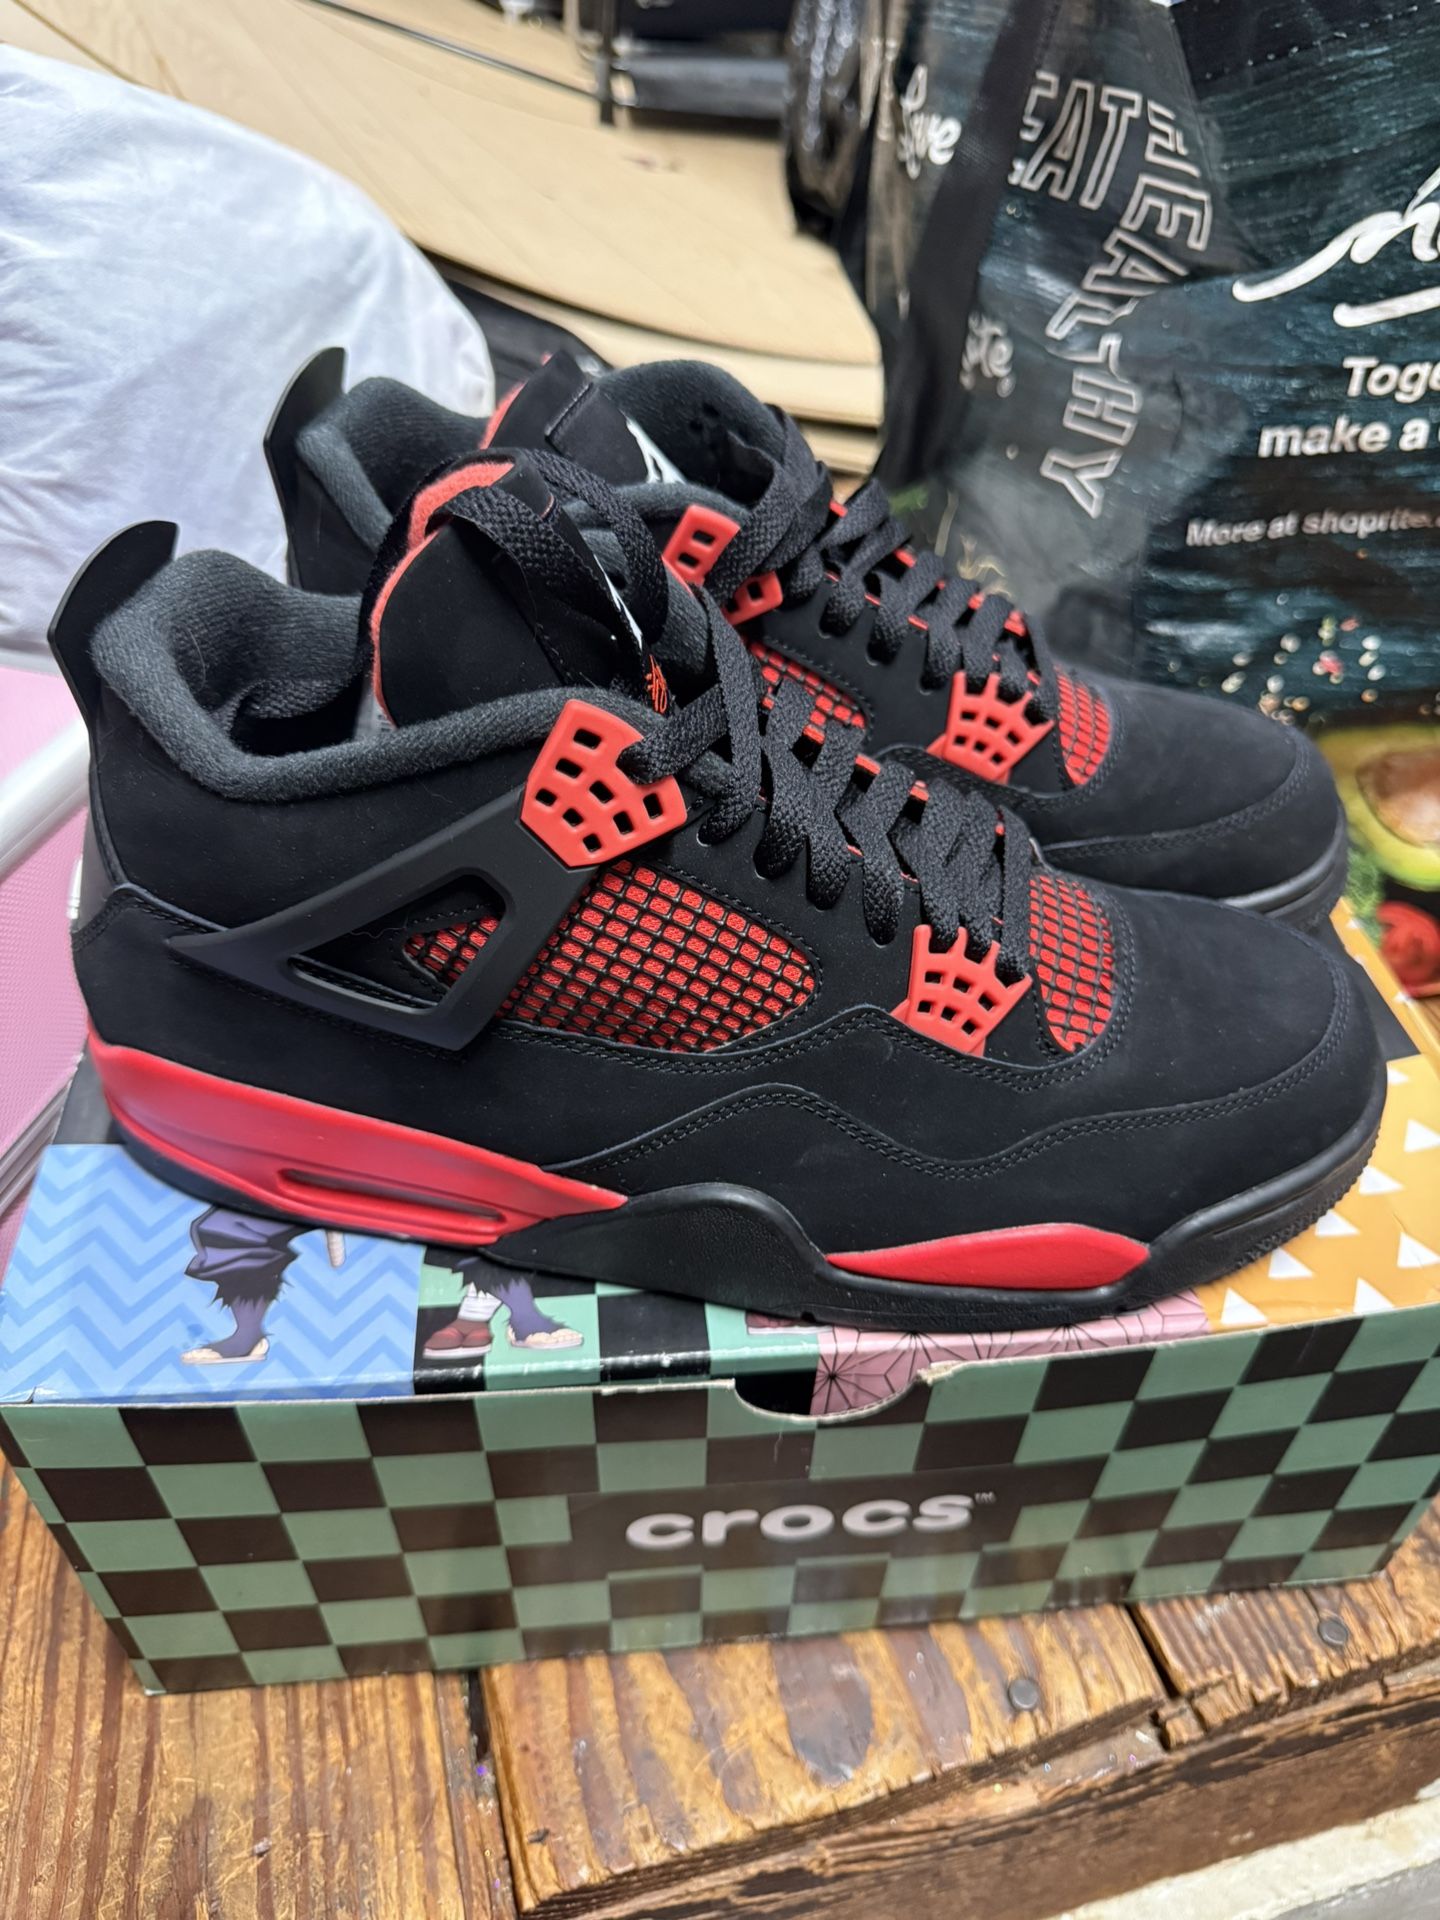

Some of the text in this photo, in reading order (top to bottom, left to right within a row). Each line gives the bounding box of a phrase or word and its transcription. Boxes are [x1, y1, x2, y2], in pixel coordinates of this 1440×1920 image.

[1257, 413, 1431, 458] make a
[1186, 517, 1268, 547] More
[1267, 510, 1299, 540] at
[625, 1493, 974, 1550] crocs
